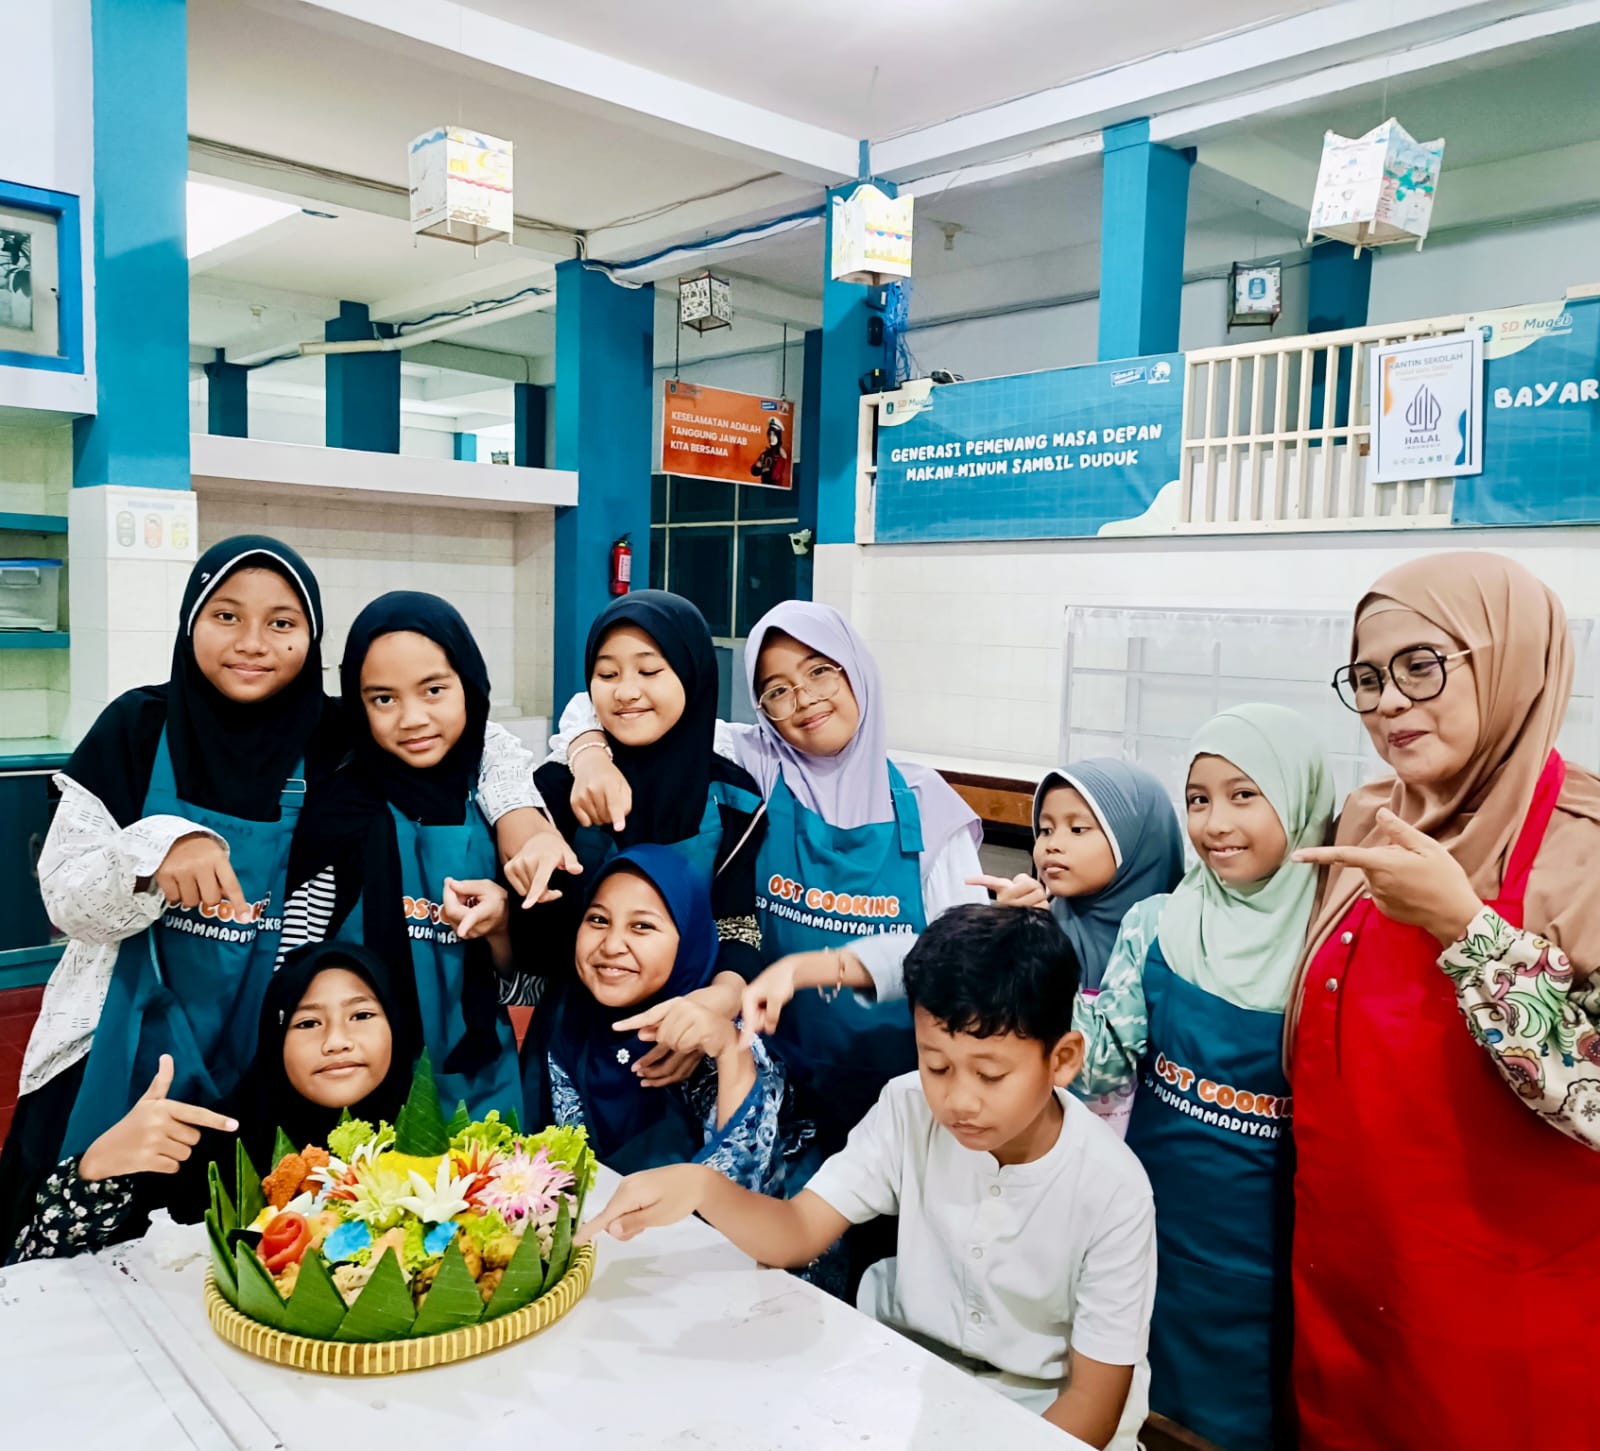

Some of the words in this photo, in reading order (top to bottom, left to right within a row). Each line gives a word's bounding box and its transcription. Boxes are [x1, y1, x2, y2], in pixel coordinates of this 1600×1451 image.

[1500, 320, 1520, 333] SD
[1389, 359, 1422, 369] KANTIN
[1424, 353, 1464, 365] SEKOLAH
[1494, 379, 1599, 409] BAYAR
[671, 411, 729, 428] KESELAMATAN
[730, 421, 761, 434] ADALAH
[671, 426, 718, 441] TANGGUNG
[718, 434, 748, 446] JAWAB
[891, 441, 961, 463] GENERASI
[966, 433, 1047, 456] PEMENANG
[1053, 429, 1097, 447] MASA
[1103, 423, 1163, 444] DEPAN
[1404, 433, 1441, 445] HALAL
[670, 440, 689, 451] KITA
[690, 442, 729, 457] BERSAMA
[1012, 455, 1074, 474] SAMBIL
[1079, 449, 1138, 468] DUDUK
[768, 874, 804, 903] OST
[805, 887, 900, 917] COOKING
[755, 896, 768, 909] SD
[769, 901, 875, 936] MUHAMMADIYAH
[1155, 1052, 1196, 1092] OST
